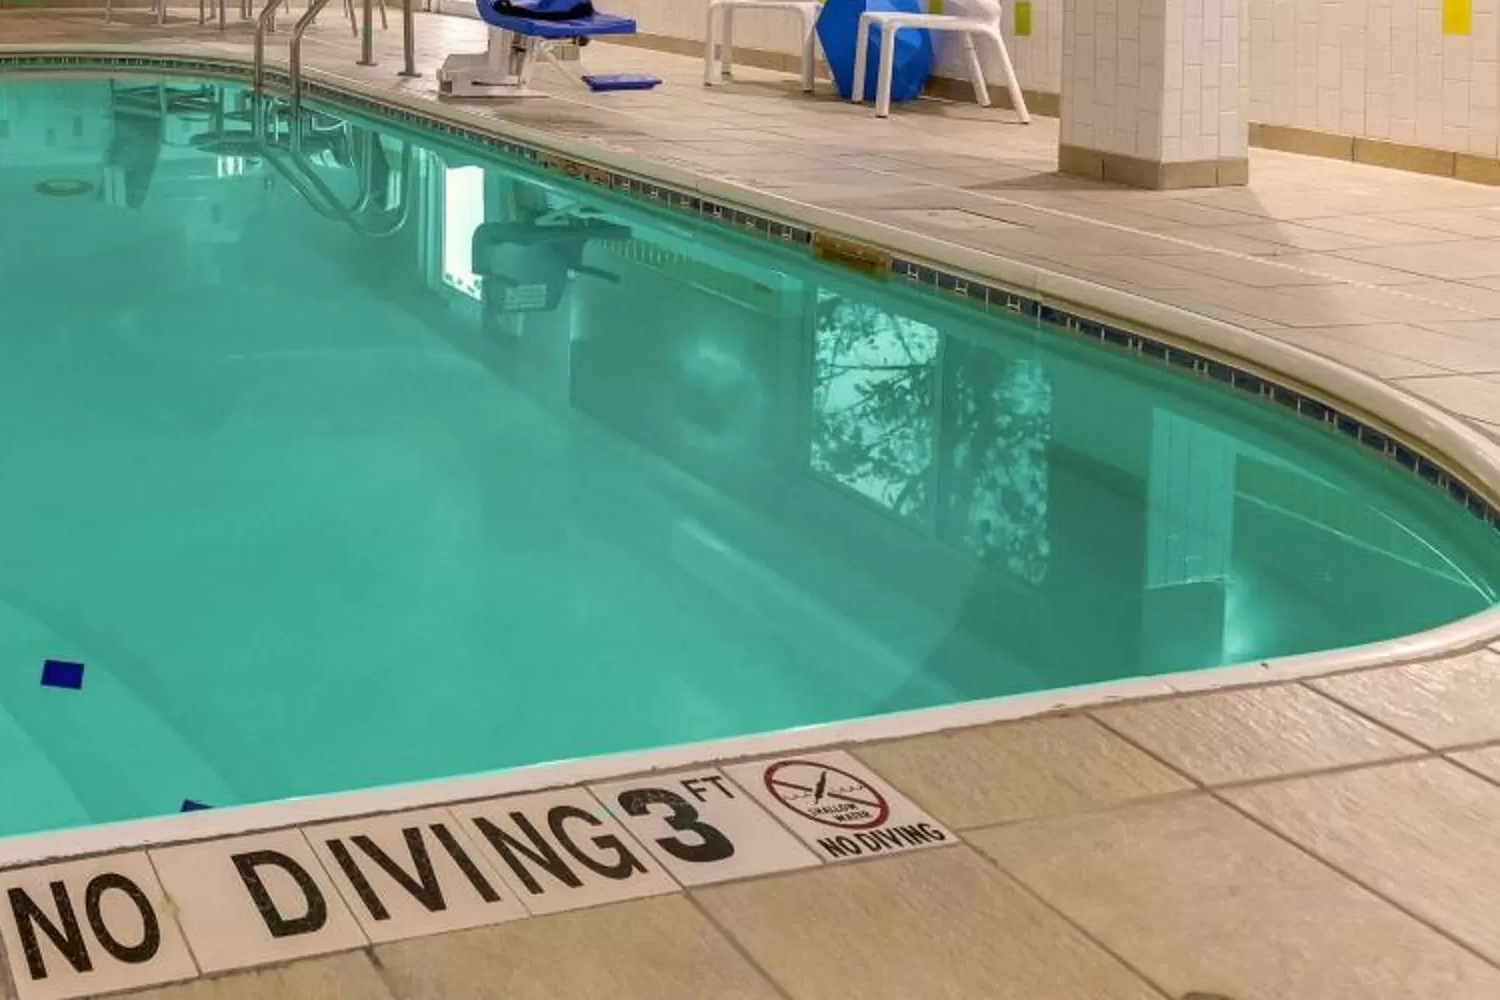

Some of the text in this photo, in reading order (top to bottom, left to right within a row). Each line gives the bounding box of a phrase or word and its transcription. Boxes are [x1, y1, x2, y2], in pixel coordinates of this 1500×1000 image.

[617, 775, 736, 863] 3 FT
[807, 803, 859, 816] SHALLOW
[833, 810, 871, 822] WATER
[816, 823, 946, 858] NO DIVING
[7, 805, 649, 981] NO DIVING
